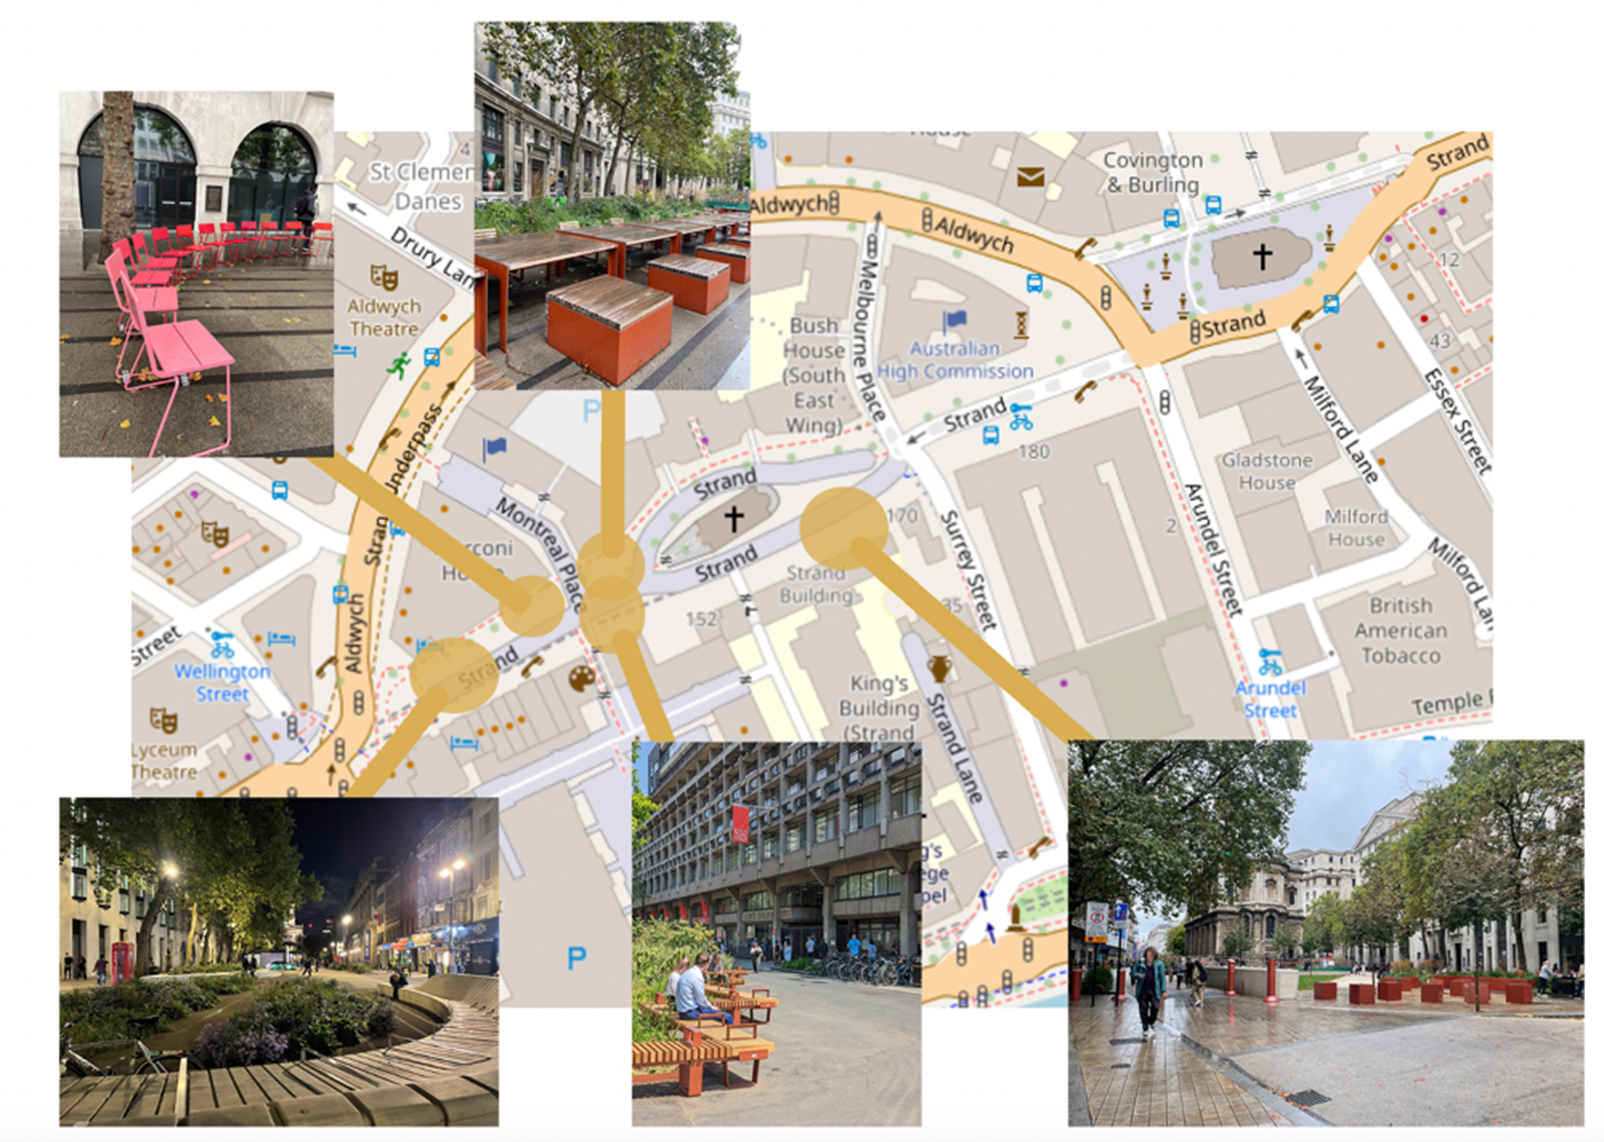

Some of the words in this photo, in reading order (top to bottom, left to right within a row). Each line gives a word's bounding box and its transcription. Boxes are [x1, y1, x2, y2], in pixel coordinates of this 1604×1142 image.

[460, 142, 470, 156] 4
[1427, 133, 1490, 172] Strand
[370, 163, 391, 181] St
[397, 162, 475, 181] Clemen
[1103, 152, 1203, 173] Covington
[1107, 178, 1125, 193] &
[1128, 177, 1200, 198] Burling
[395, 192, 462, 210] Danes
[750, 192, 829, 216] Aldwych
[935, 217, 1014, 255] Aldwych
[390, 226, 442, 269] Drury
[443, 260, 475, 290] Lan
[1440, 253, 1459, 268] 12
[347, 299, 421, 318] Aldwych
[853, 260, 877, 369] Melbourne
[350, 321, 419, 337] Theatre
[790, 317, 838, 334] Bush
[1201, 310, 1267, 339] Strand
[910, 341, 1000, 357] Australian
[1429, 333, 1452, 349] 43
[783, 343, 845, 359] House
[782, 367, 846, 385] (South
[877, 363, 919, 382] High
[924, 363, 1034, 379] Commission
[794, 393, 834, 409] East
[857, 372, 886, 422] Place
[943, 397, 1008, 433] Strand
[1425, 367, 1460, 420] Essex
[1455, 420, 1493, 477] Street
[786, 417, 843, 437] Wing)
[1304, 375, 1356, 441] Milford
[1345, 436, 1379, 485] Lane
[1019, 445, 1050, 459] 180
[1222, 452, 1313, 469] Gladstone
[694, 467, 757, 501] Strand
[1239, 475, 1297, 490] House
[887, 509, 918, 524] 170
[1167, 519, 1177, 533] 2
[1325, 508, 1389, 525] Milford
[365, 515, 389, 567] Stran
[1328, 532, 1386, 547] House
[496, 497, 561, 562] Montreal
[559, 564, 587, 614] Place
[1185, 483, 1223, 556] Arundel
[1212, 558, 1244, 619] Street
[696, 545, 758, 583] Strand
[786, 566, 846, 581] Strand
[941, 509, 977, 571] Surrey
[967, 574, 998, 632] Street
[1428, 536, 1484, 595] Milford
[1474, 595, 1493, 632] Lan
[779, 588, 853, 607] Building
[1370, 597, 1433, 614] British
[686, 612, 717, 627] 152
[345, 592, 367, 674] Aldwych
[1355, 623, 1447, 639] American
[131, 625, 182, 667] Street
[1362, 647, 1441, 664] Tobacco
[175, 664, 271, 683] Wellington
[458, 645, 519, 690] Strand
[196, 686, 249, 702] Street
[850, 675, 909, 694] King's
[1235, 680, 1306, 696] Arundel
[839, 700, 920, 720] Building
[1244, 703, 1297, 718] Street
[1411, 691, 1484, 715] Temple
[844, 725, 914, 742] (Strand
[131, 743, 197, 761] Lyceum
[927, 693, 966, 757] Strand
[955, 759, 983, 804] Lane
[131, 765, 197, 780] Theatre
